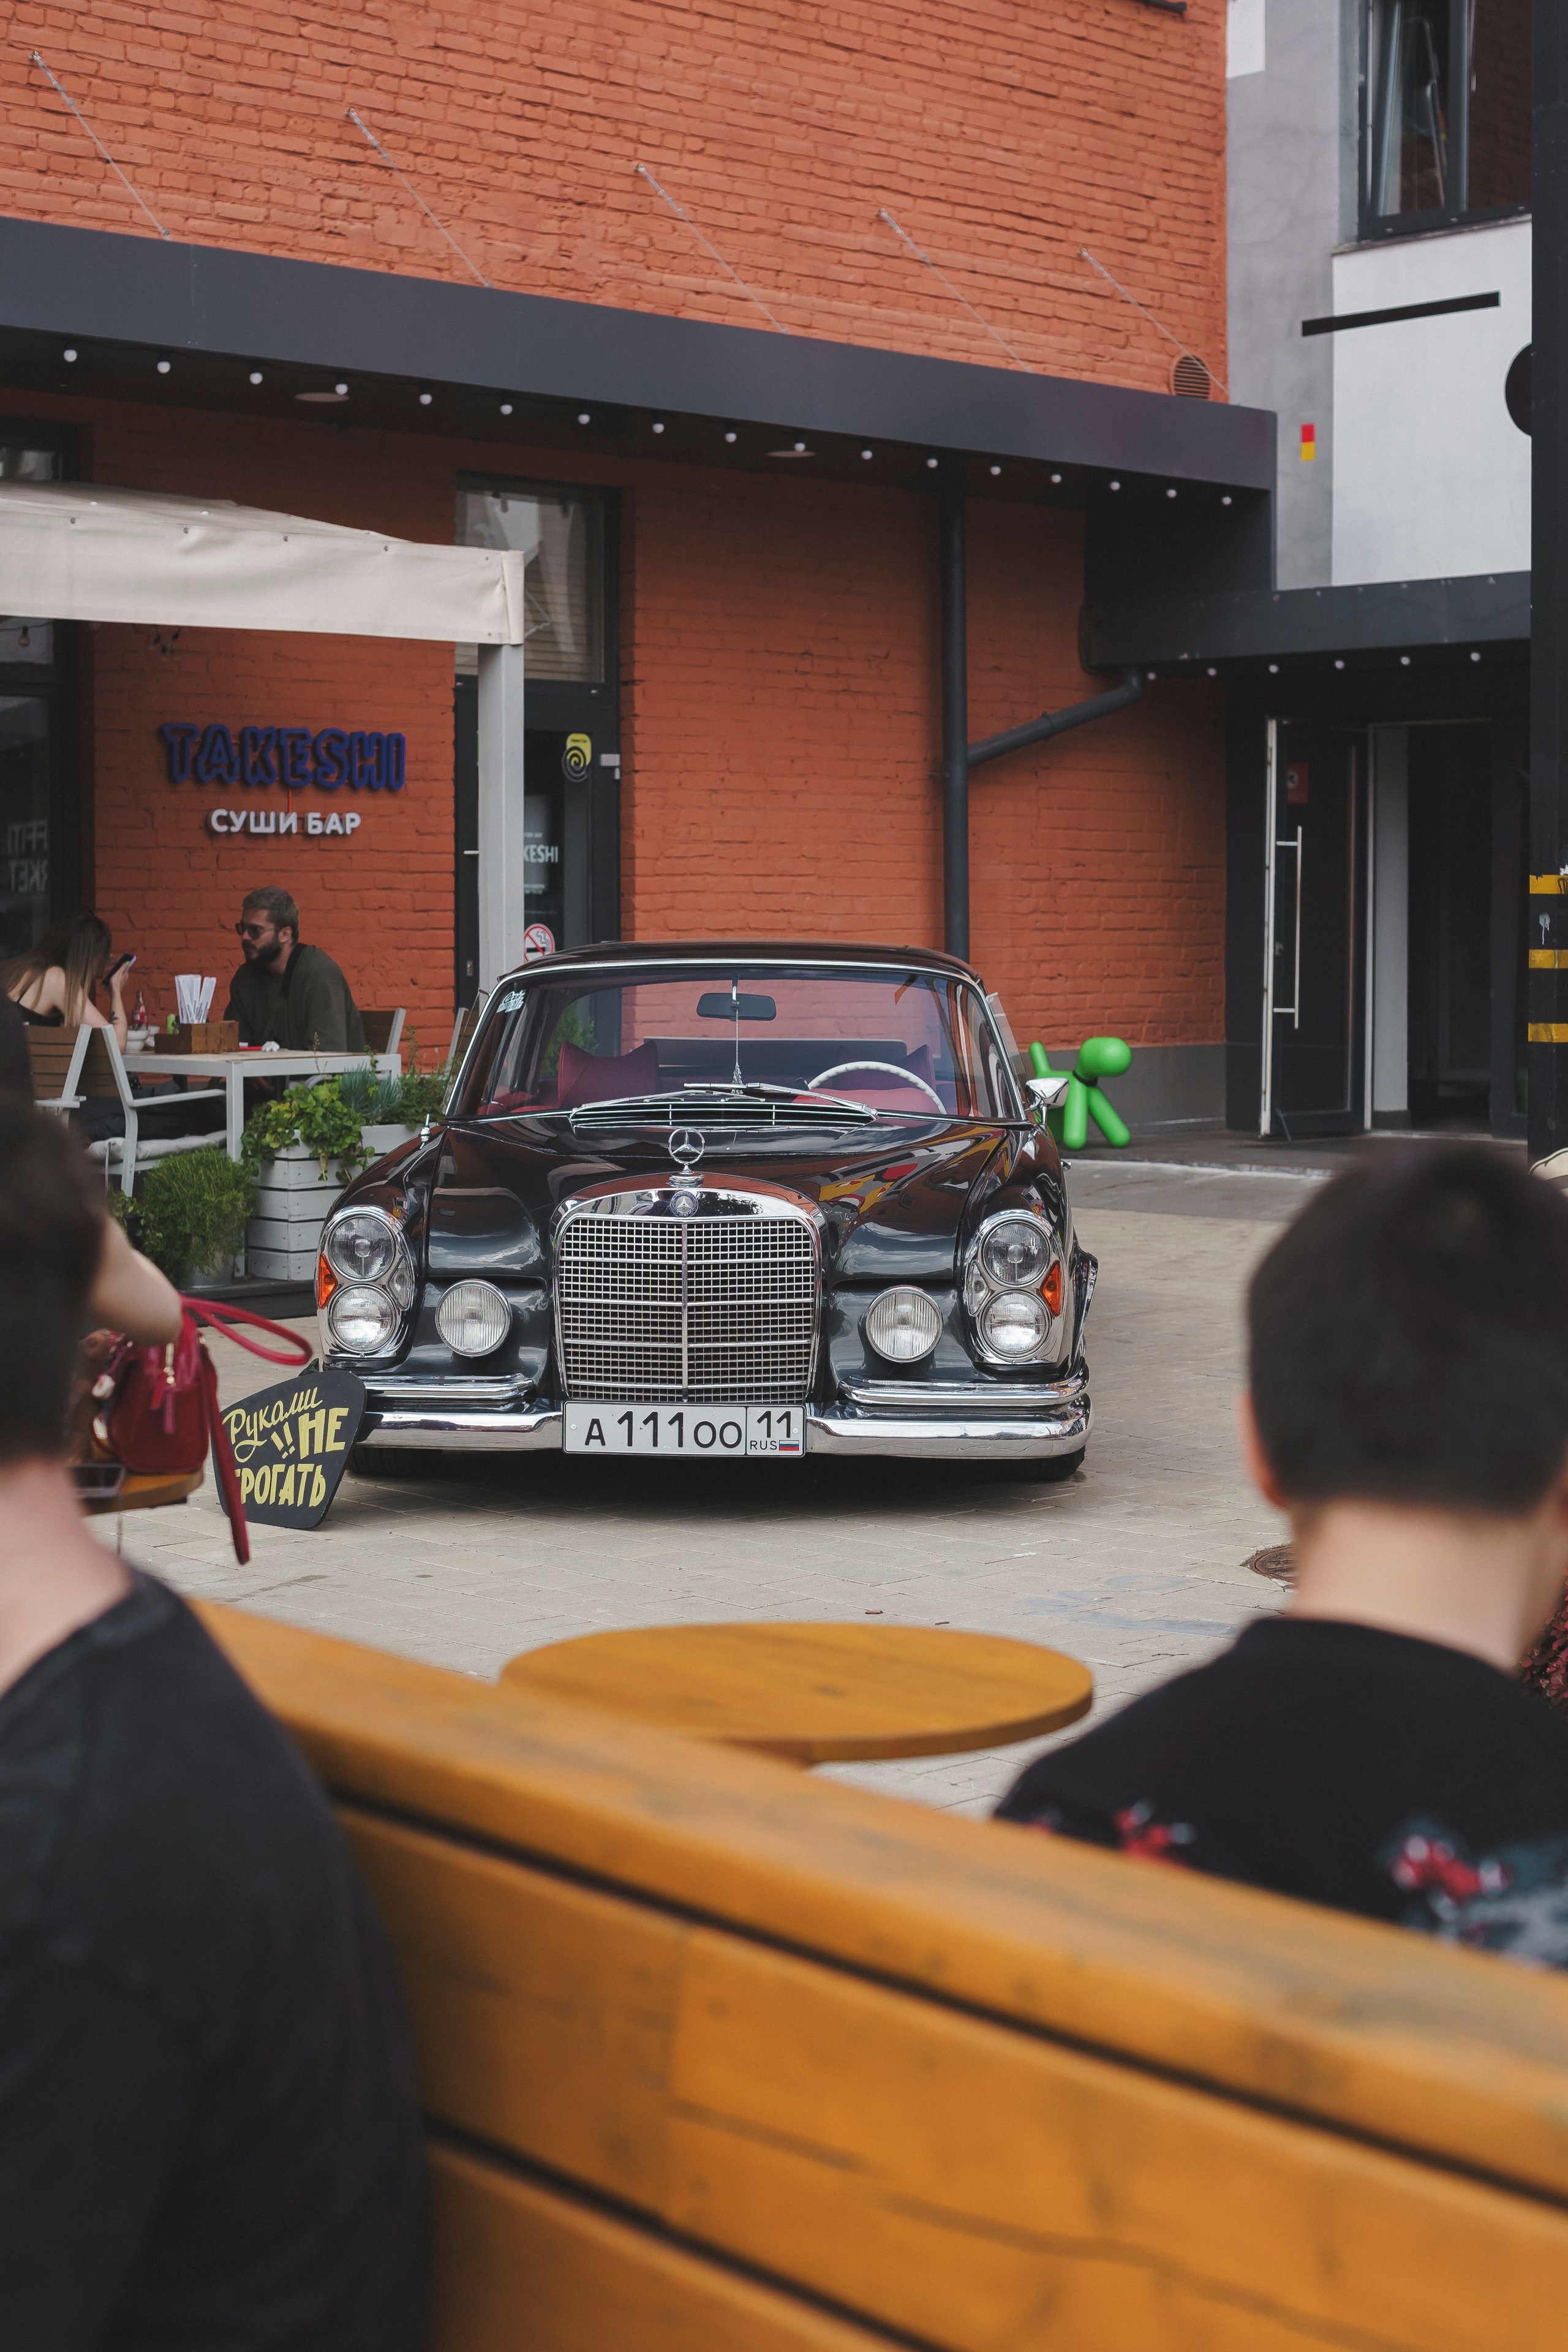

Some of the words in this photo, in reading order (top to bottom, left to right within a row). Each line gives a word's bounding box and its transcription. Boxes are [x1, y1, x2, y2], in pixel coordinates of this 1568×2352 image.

[161, 722, 407, 790] TAKESHI
[209, 809, 298, 834] СУШИ
[306, 812, 362, 835] БАР
[523, 844, 559, 863] KESHI
[222, 1387, 323, 1463] Руками
[298, 1408, 349, 1460] НЕ
[756, 1410, 791, 1438] 11
[750, 1440, 777, 1450] RUS
[235, 1463, 326, 1507] РОГАТЬ
